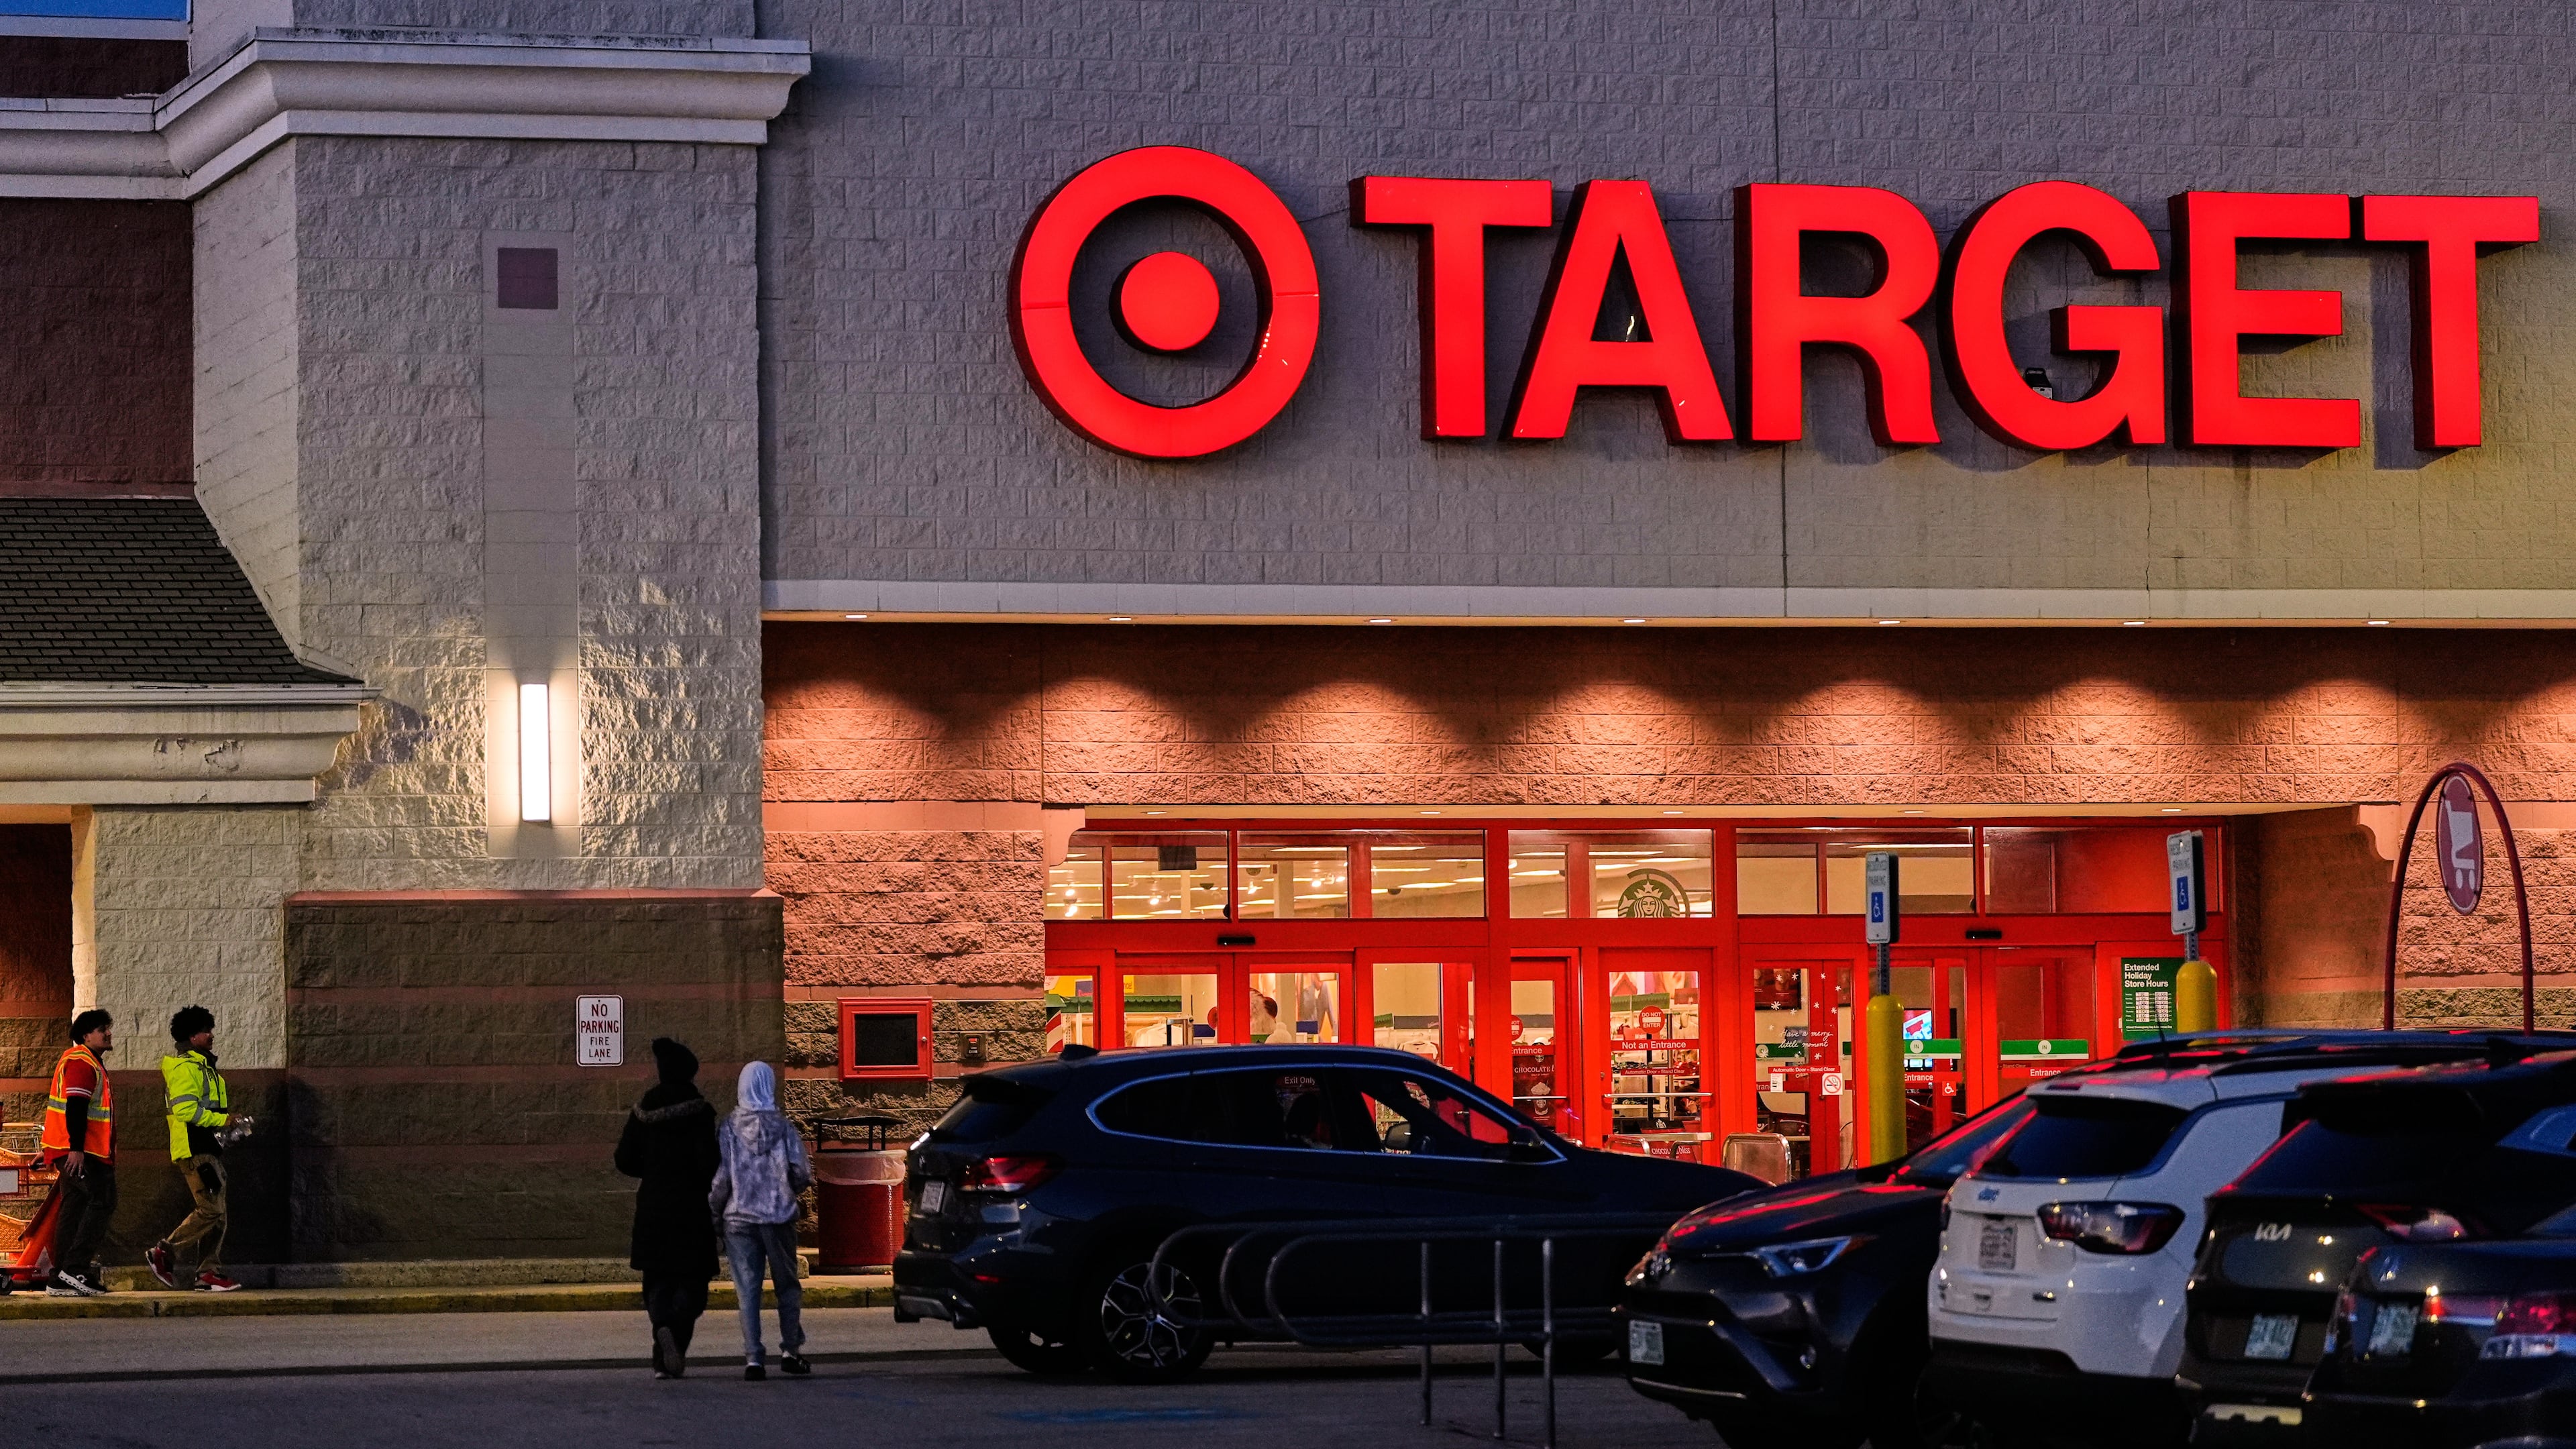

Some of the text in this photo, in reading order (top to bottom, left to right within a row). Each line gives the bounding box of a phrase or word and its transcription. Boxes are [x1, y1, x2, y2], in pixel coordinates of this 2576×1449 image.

[1351, 176, 2540, 449] TARGET
[2124, 971, 2152, 980] Holiday
[592, 1004, 608, 1017] NO
[580, 1020, 619, 1033] PARKING
[1780, 1029, 1799, 1037] Have
[1811, 1031, 1834, 1040] merry
[590, 1036, 610, 1045] FIRE
[1622, 1041, 1636, 1049] Not
[1778, 1040, 1799, 1048] little
[589, 1049, 611, 1058] LANE
[1284, 1076, 1316, 1085] Exit Only
[1678, 1146, 1690, 1154] bliss
[2254, 1222, 2293, 1240] KIA
